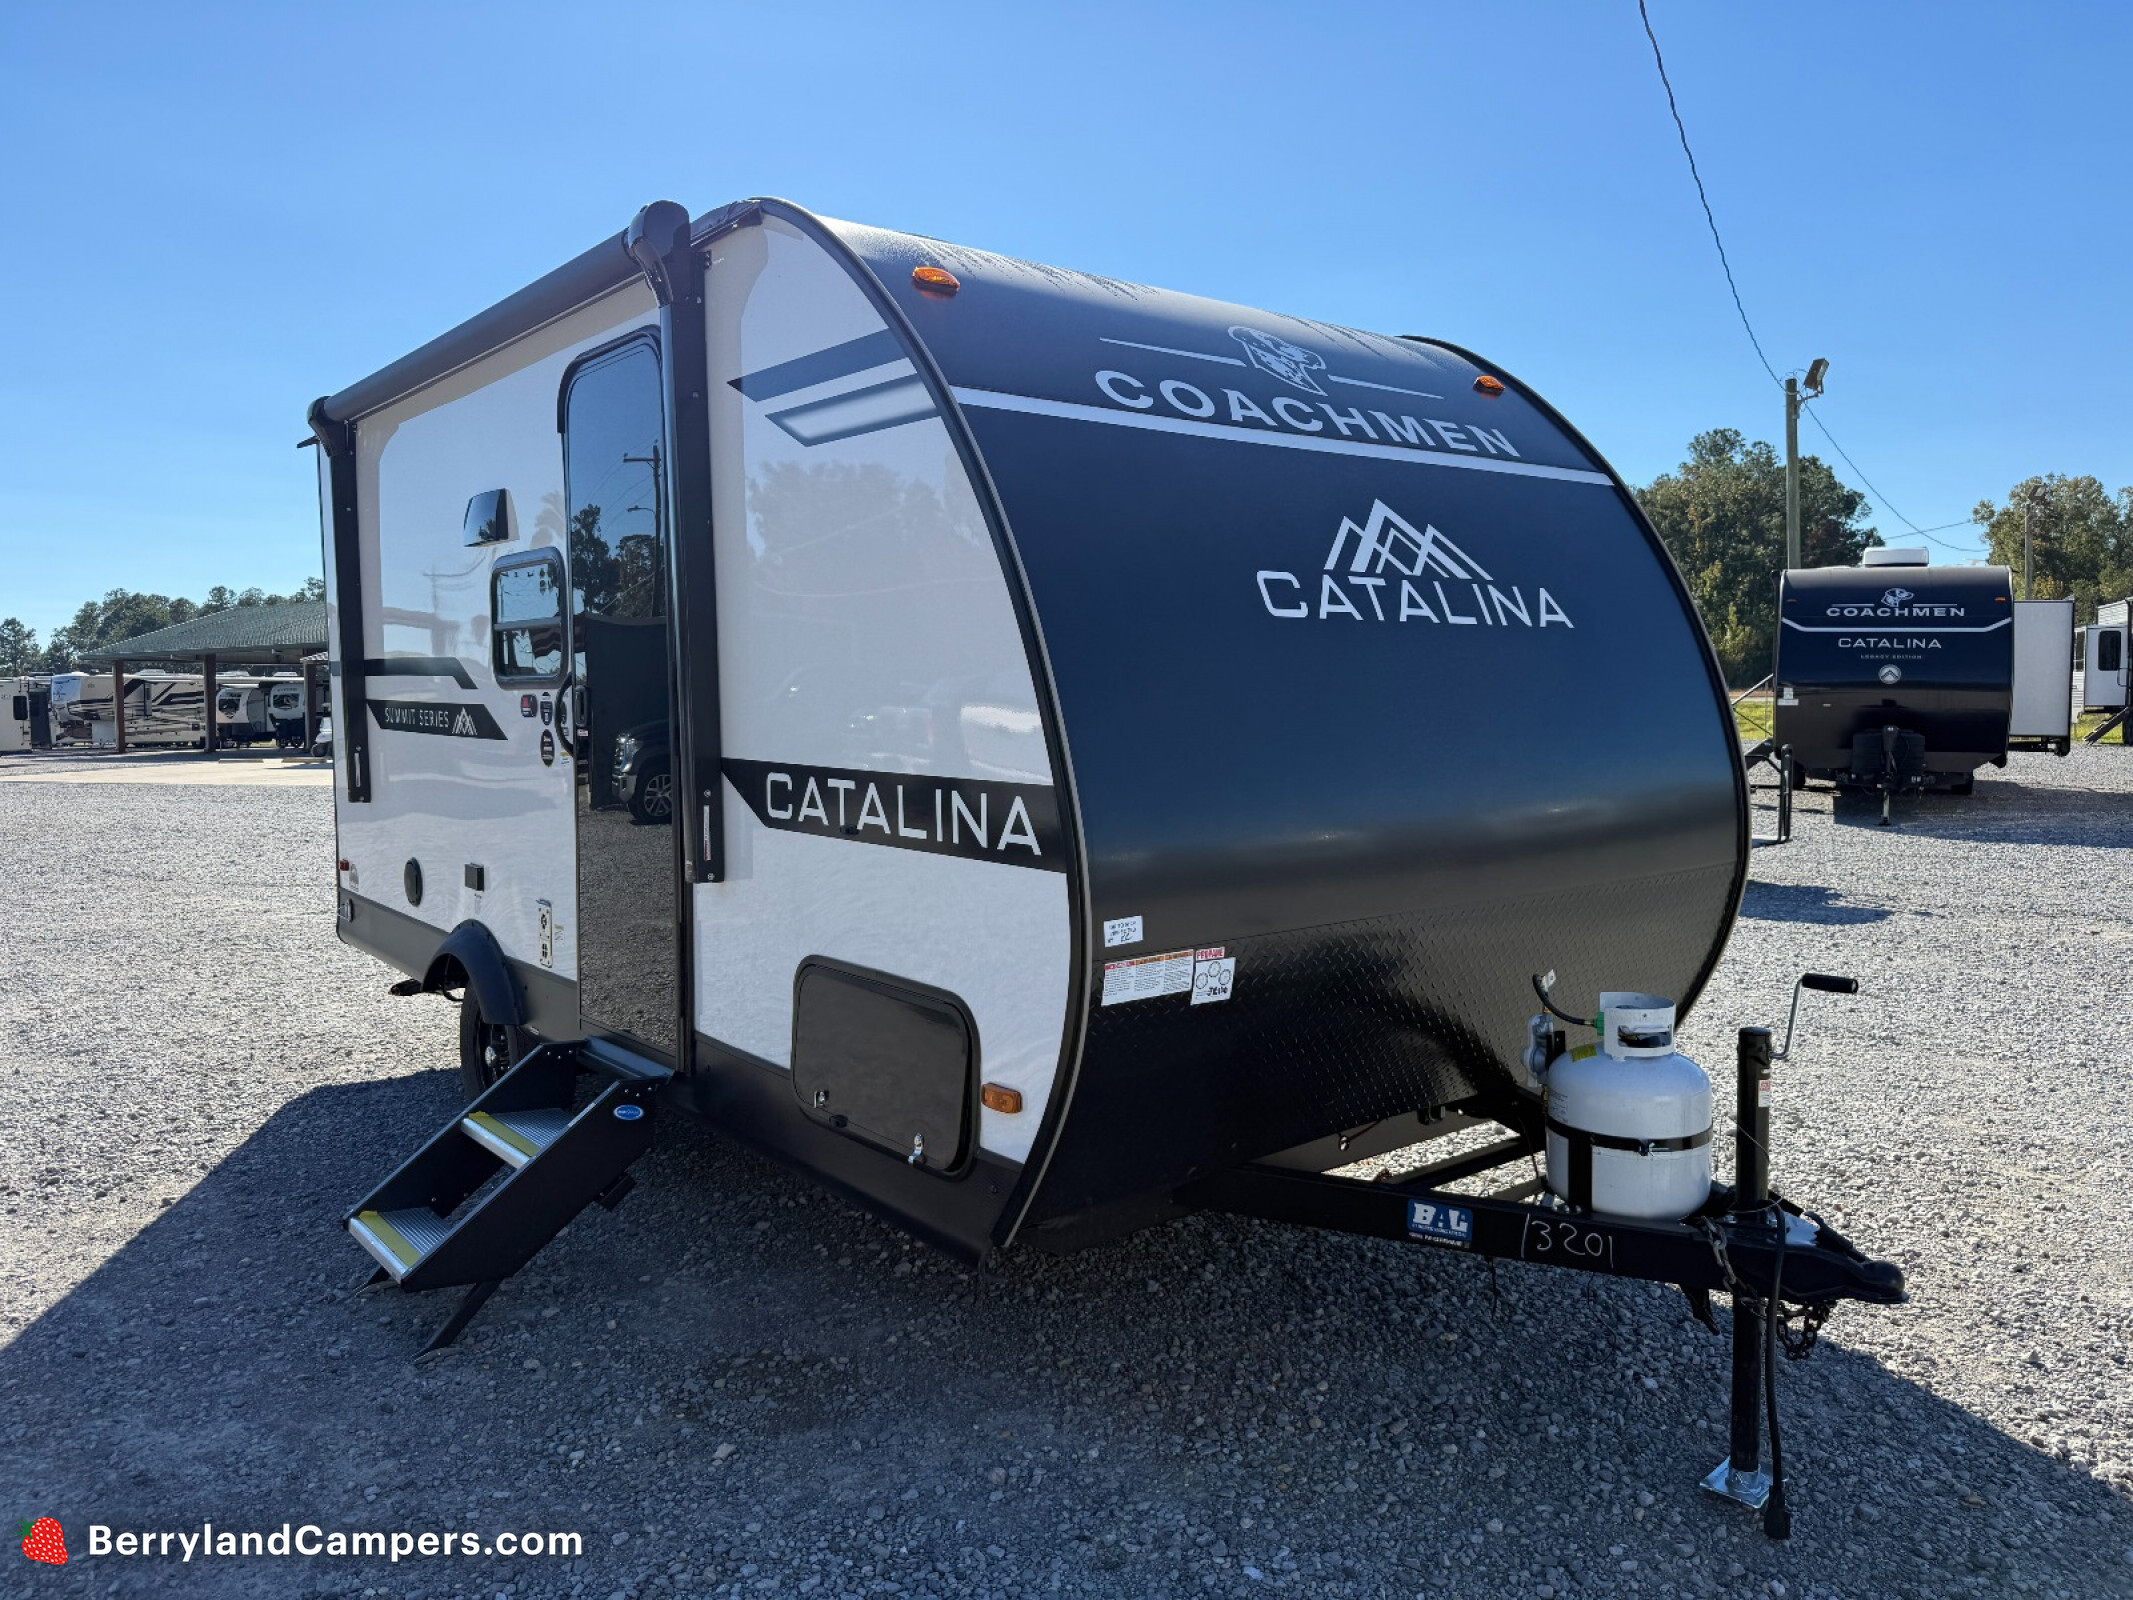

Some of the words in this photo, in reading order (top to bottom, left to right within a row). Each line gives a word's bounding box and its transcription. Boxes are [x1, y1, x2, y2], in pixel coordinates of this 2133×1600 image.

[1095, 370, 1520, 457] COACHMEN
[1256, 570, 1575, 628] CATALINA
[1825, 607, 1965, 617] COACHMEN
[1837, 637, 1942, 649] CATALINA
[384, 707, 416, 725] SUMMIT
[419, 709, 450, 728] SERIES
[765, 771, 1042, 856] CATALINA
[1412, 1202, 1468, 1233] BAL
[1520, 1212, 1614, 1269] 13201
